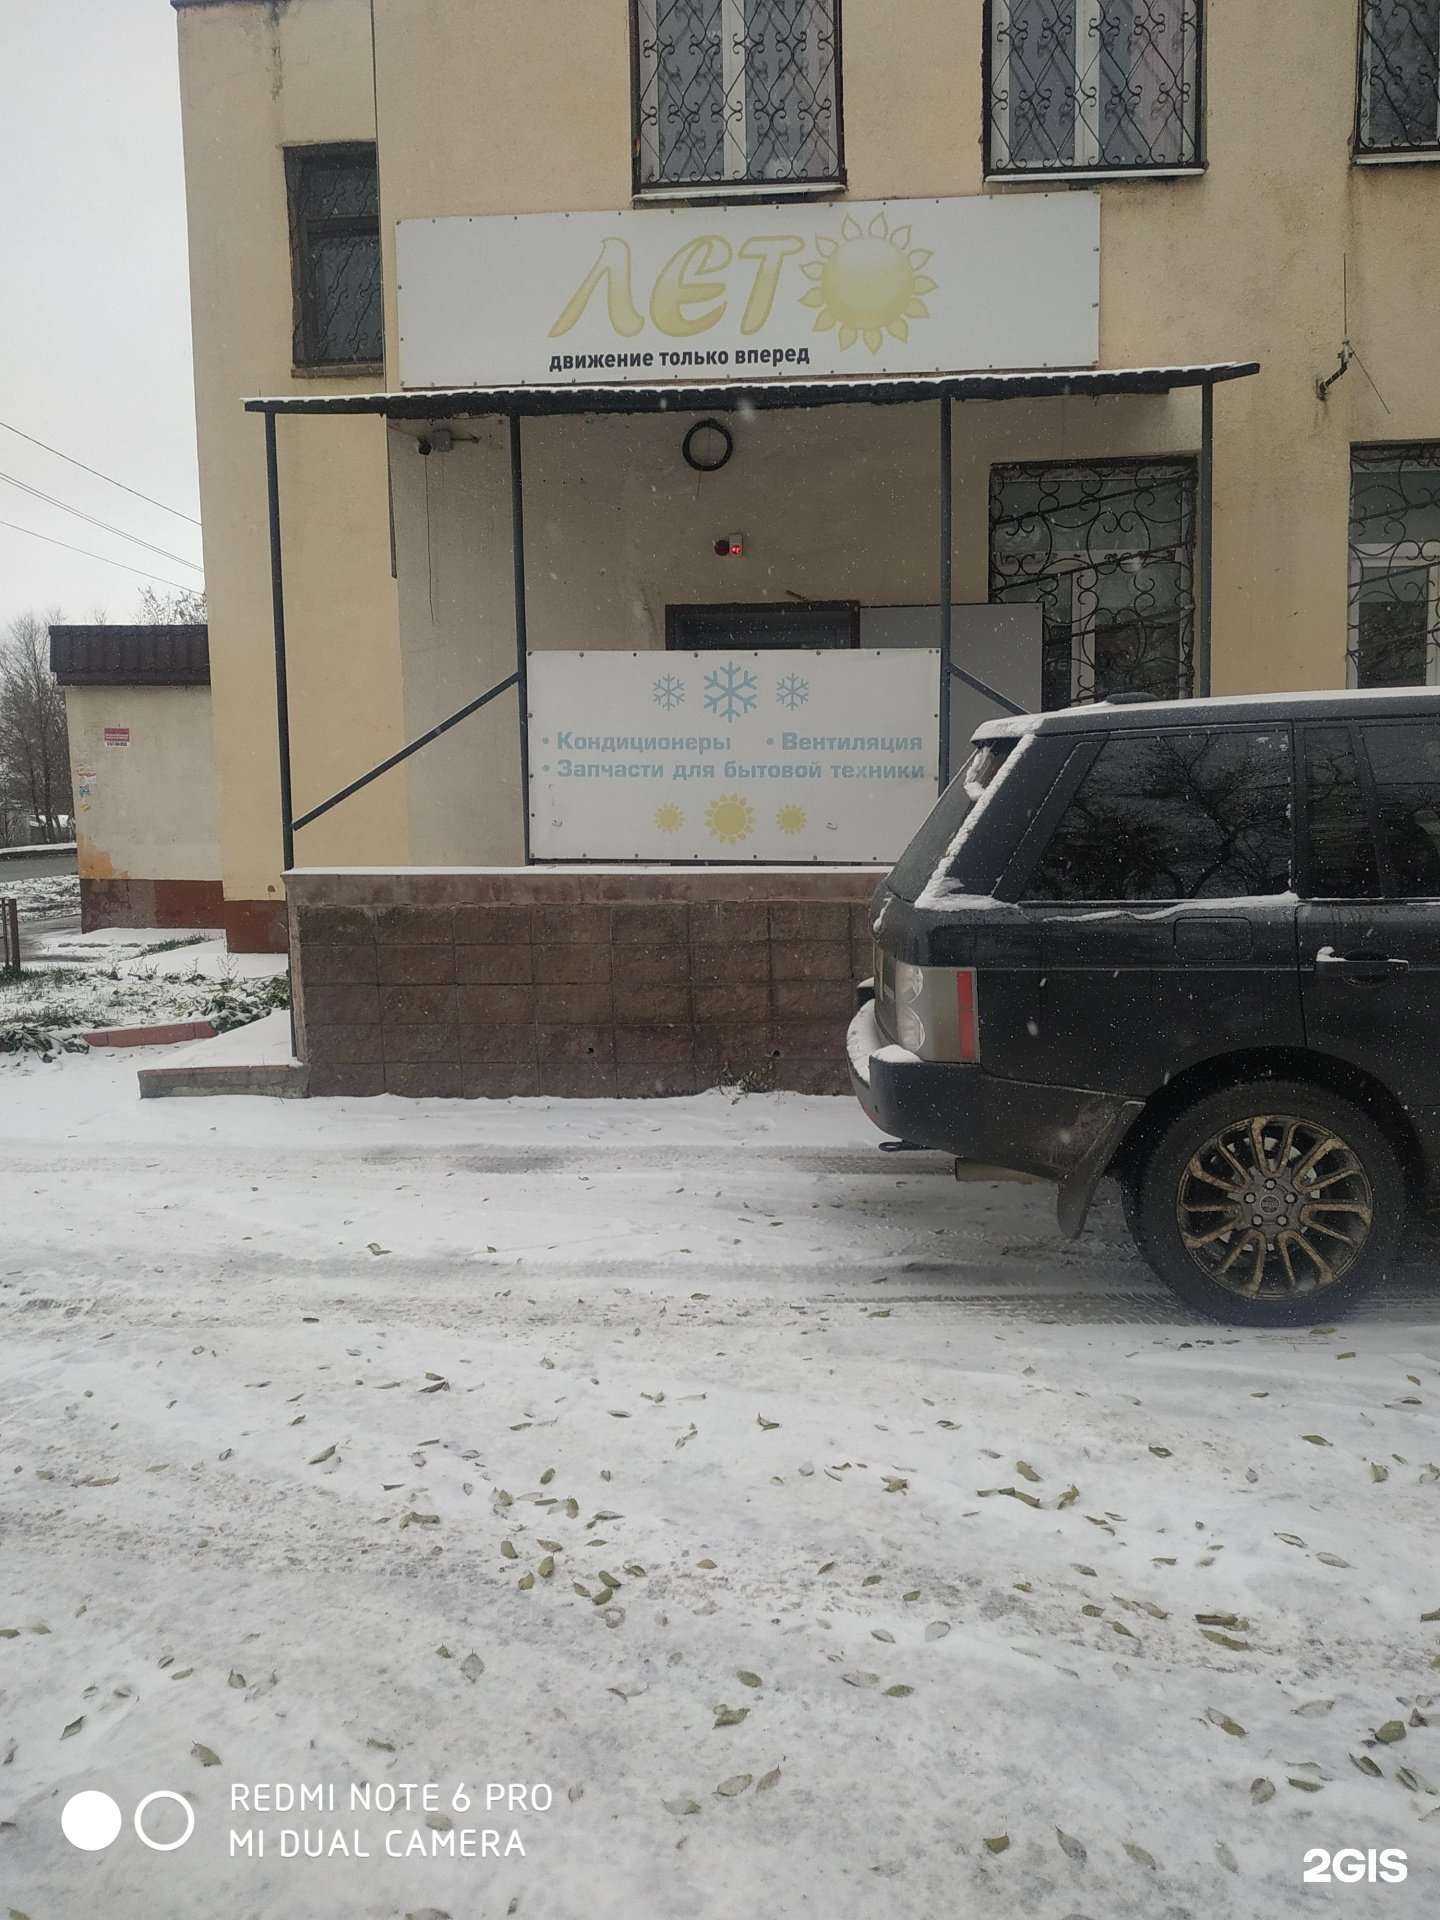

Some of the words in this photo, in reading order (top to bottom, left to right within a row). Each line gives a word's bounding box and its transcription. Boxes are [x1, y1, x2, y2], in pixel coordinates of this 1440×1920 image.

[549, 351, 654, 372] движение
[659, 350, 729, 367] только
[735, 347, 810, 366] вперед
[556, 731, 731, 755] Кондиционеры
[782, 732, 923, 753] Вентиляция
[557, 759, 664, 778] Запчасти
[672, 764, 715, 780] для
[724, 760, 822, 778] бытовой
[830, 764, 925, 778] техники
